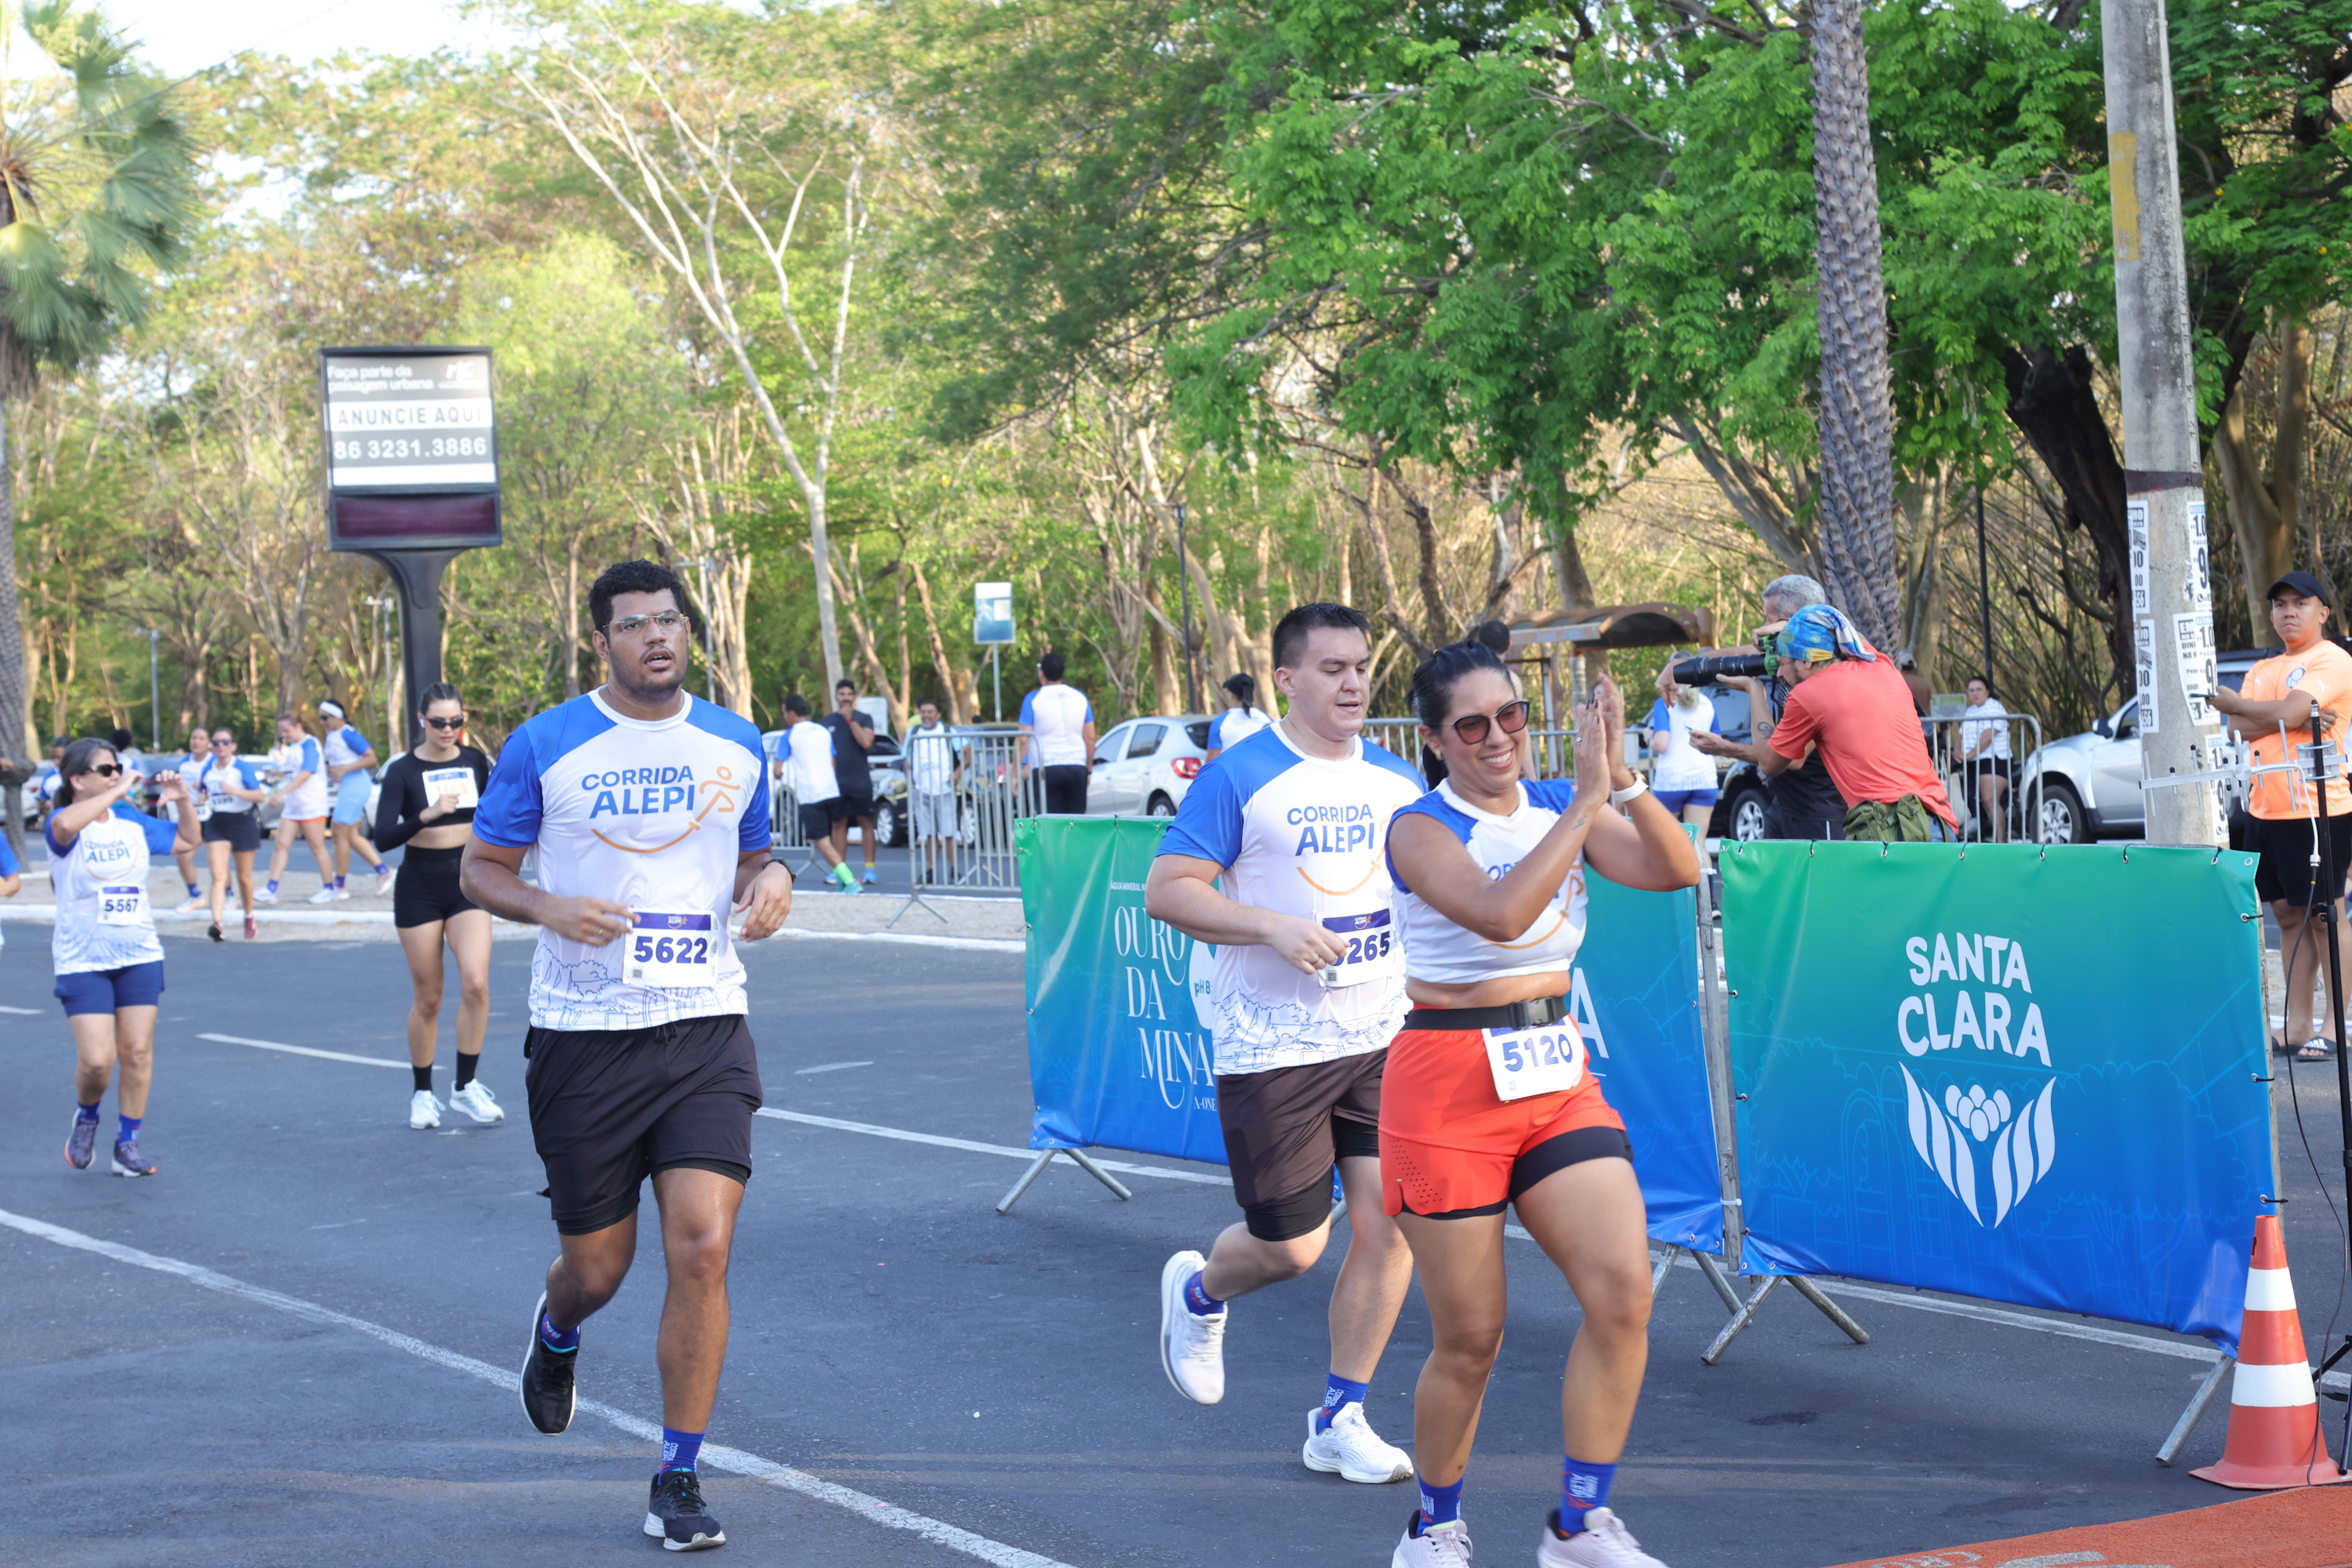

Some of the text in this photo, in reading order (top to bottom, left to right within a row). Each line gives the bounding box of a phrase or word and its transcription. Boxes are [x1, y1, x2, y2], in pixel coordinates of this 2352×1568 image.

[327, 364, 412, 381] Faça parte da
[328, 380, 388, 394] paisagem
[390, 379, 434, 390] urbana
[338, 407, 481, 425] ANUNCIE AQUI
[334, 437, 487, 459] 86 3231.3886
[582, 765, 695, 791] CORRIDA
[589, 785, 695, 819] ALEPI
[1287, 804, 1373, 826] CORRIDA
[1295, 822, 1374, 857] ALEPI
[85, 847, 130, 863] ALEPI
[104, 898, 138, 912] 5567
[633, 936, 707, 964] 5622
[1905, 932, 2032, 994] SANTA
[1125, 966, 1167, 1021] DA
[1194, 979, 1203, 996] pH
[1897, 990, 2052, 1068] CLARA
[1502, 1033, 1573, 1072] 5120
[1138, 1027, 1214, 1109] MINA
